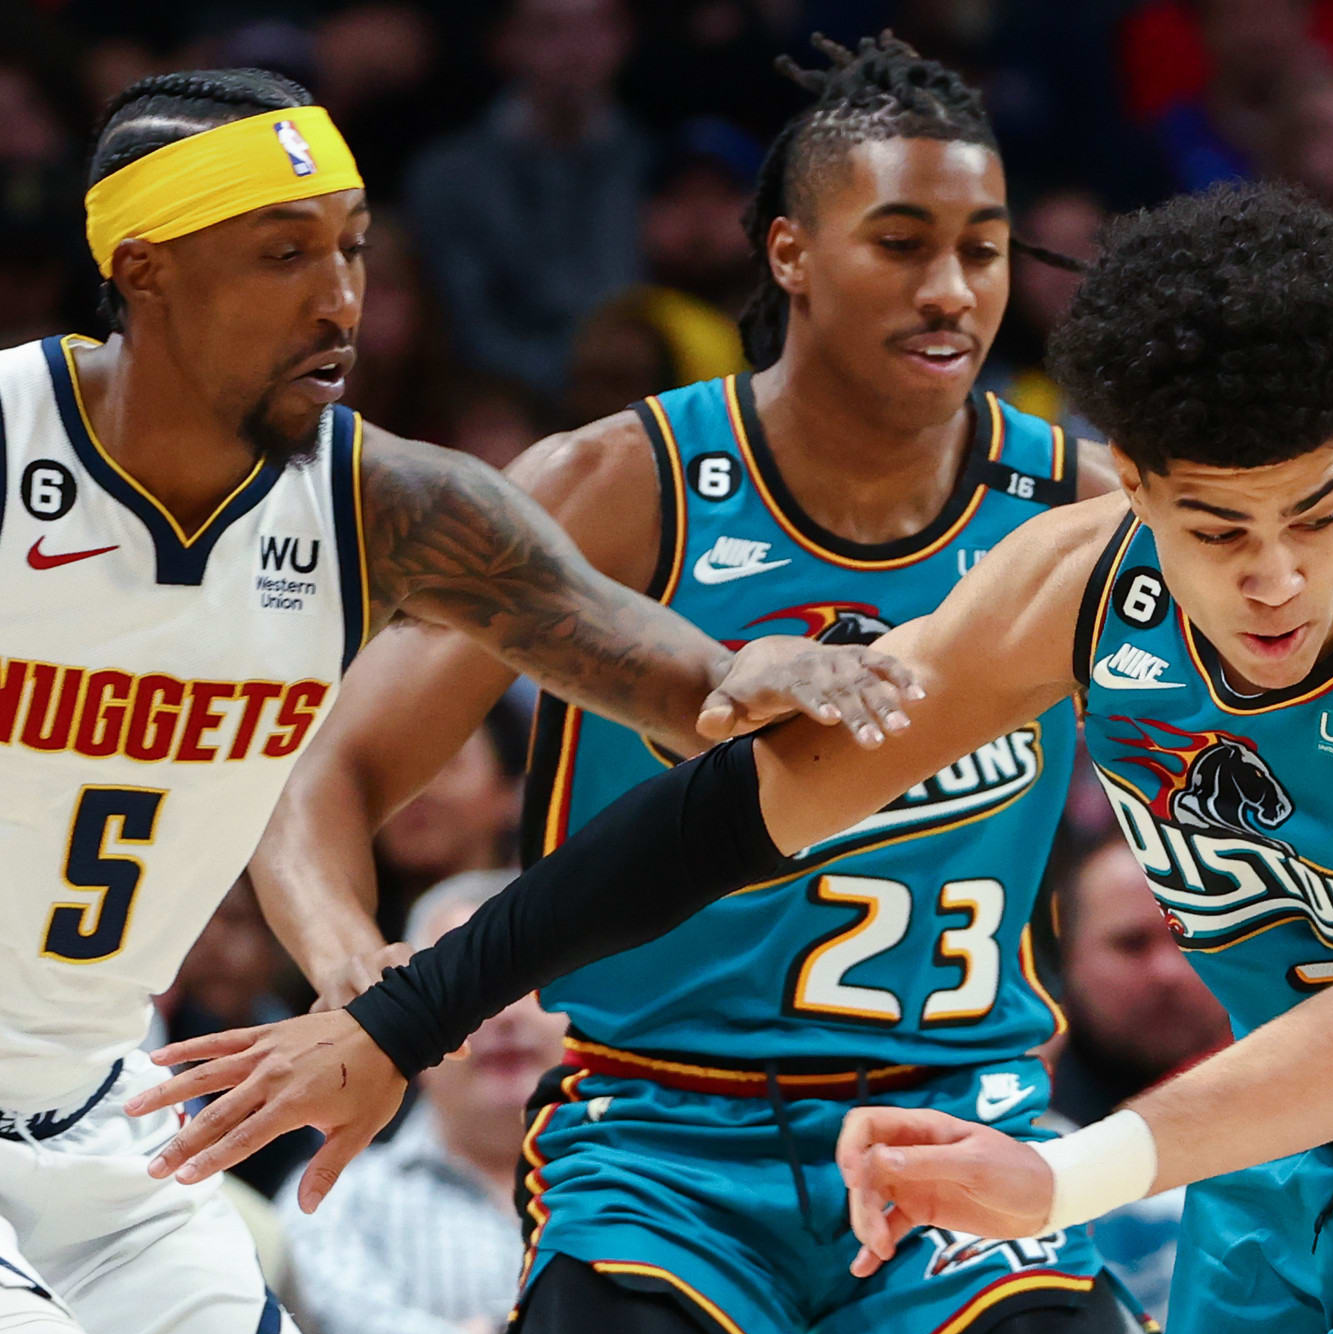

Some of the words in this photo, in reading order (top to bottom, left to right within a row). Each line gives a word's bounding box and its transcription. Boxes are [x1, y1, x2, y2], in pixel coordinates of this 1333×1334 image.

[28, 468, 64, 515] 6
[700, 456, 731, 496] 6
[1007, 472, 1036, 499] 16
[260, 535, 320, 574] WU
[709, 535, 772, 569] NIKE
[256, 575, 317, 596] Western
[261, 591, 304, 611] Union
[1121, 573, 1163, 624] 6
[1108, 642, 1170, 682] NIKE
[38, 783, 171, 965] 5
[781, 873, 1005, 1031] 23
